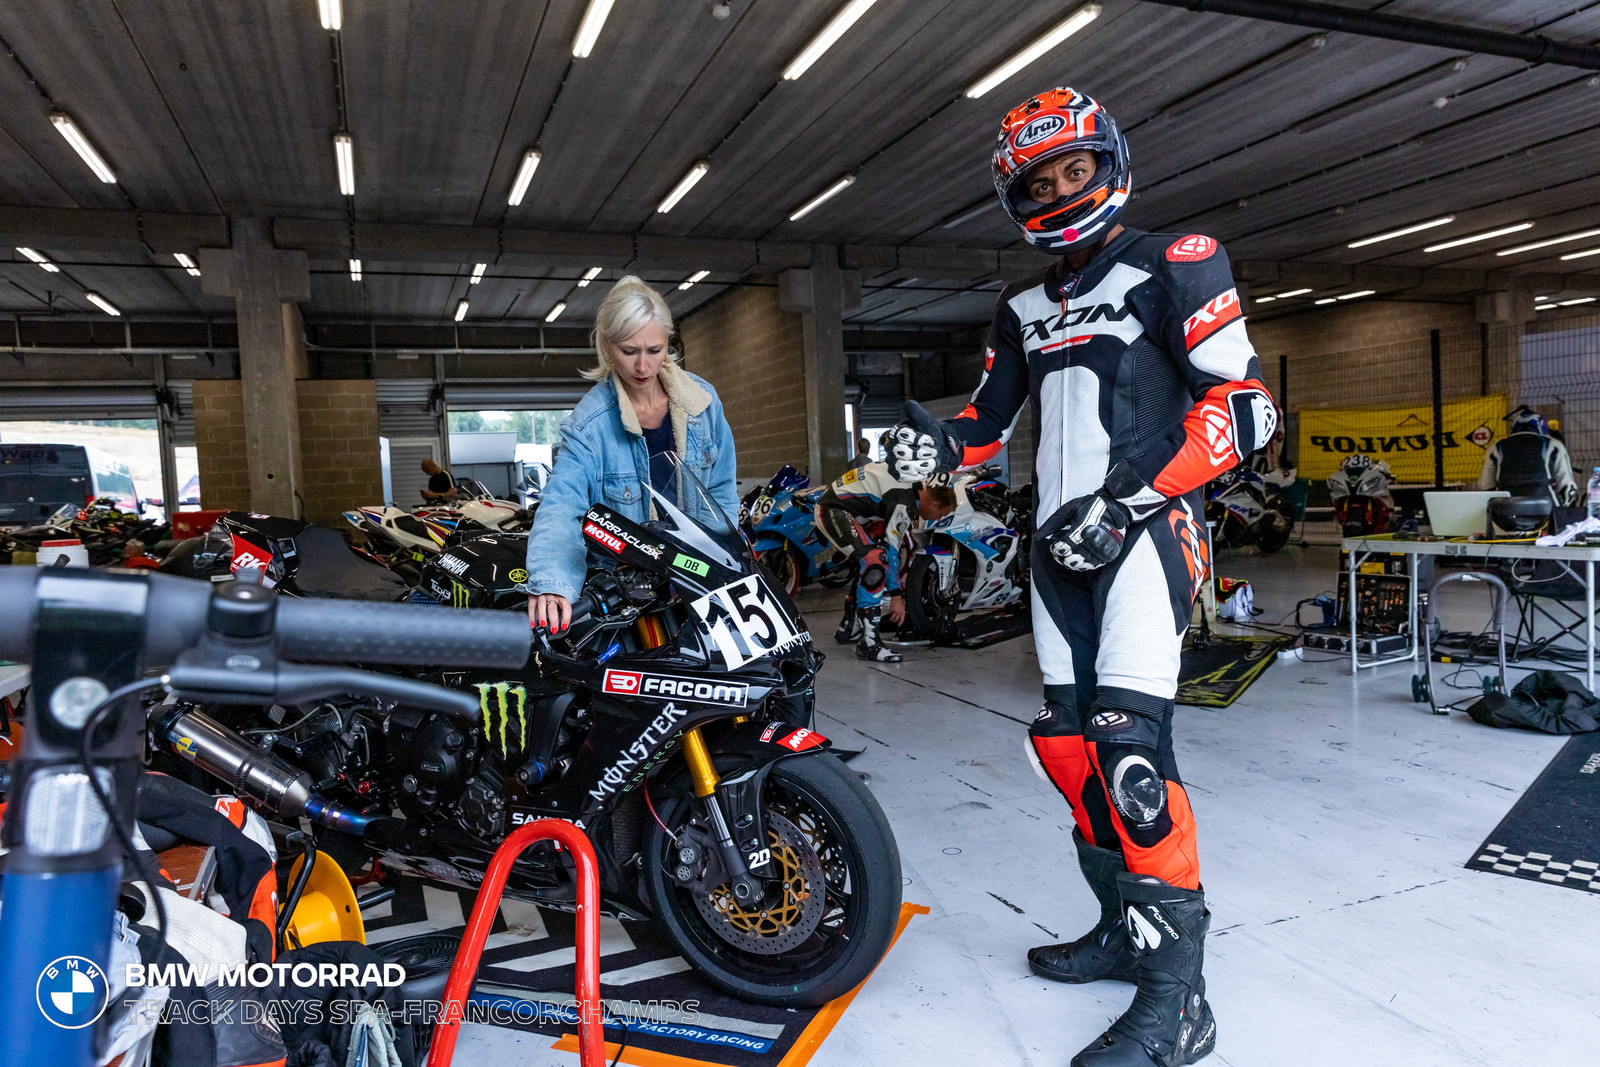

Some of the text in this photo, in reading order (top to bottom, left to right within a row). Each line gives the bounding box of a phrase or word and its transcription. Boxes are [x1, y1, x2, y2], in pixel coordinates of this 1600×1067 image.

[1018, 117, 1059, 146] Arai
[1344, 454, 1370, 468] 238
[584, 522, 623, 552] MOTUL
[586, 509, 661, 561] BARRACUDA
[684, 558, 700, 572] DB
[699, 576, 798, 664] 151
[643, 678, 742, 702] FACOM
[588, 701, 688, 802] MONSTER
[623, 729, 684, 793] ENERGY
[637, 1023, 766, 1050] FACTORY RACING
